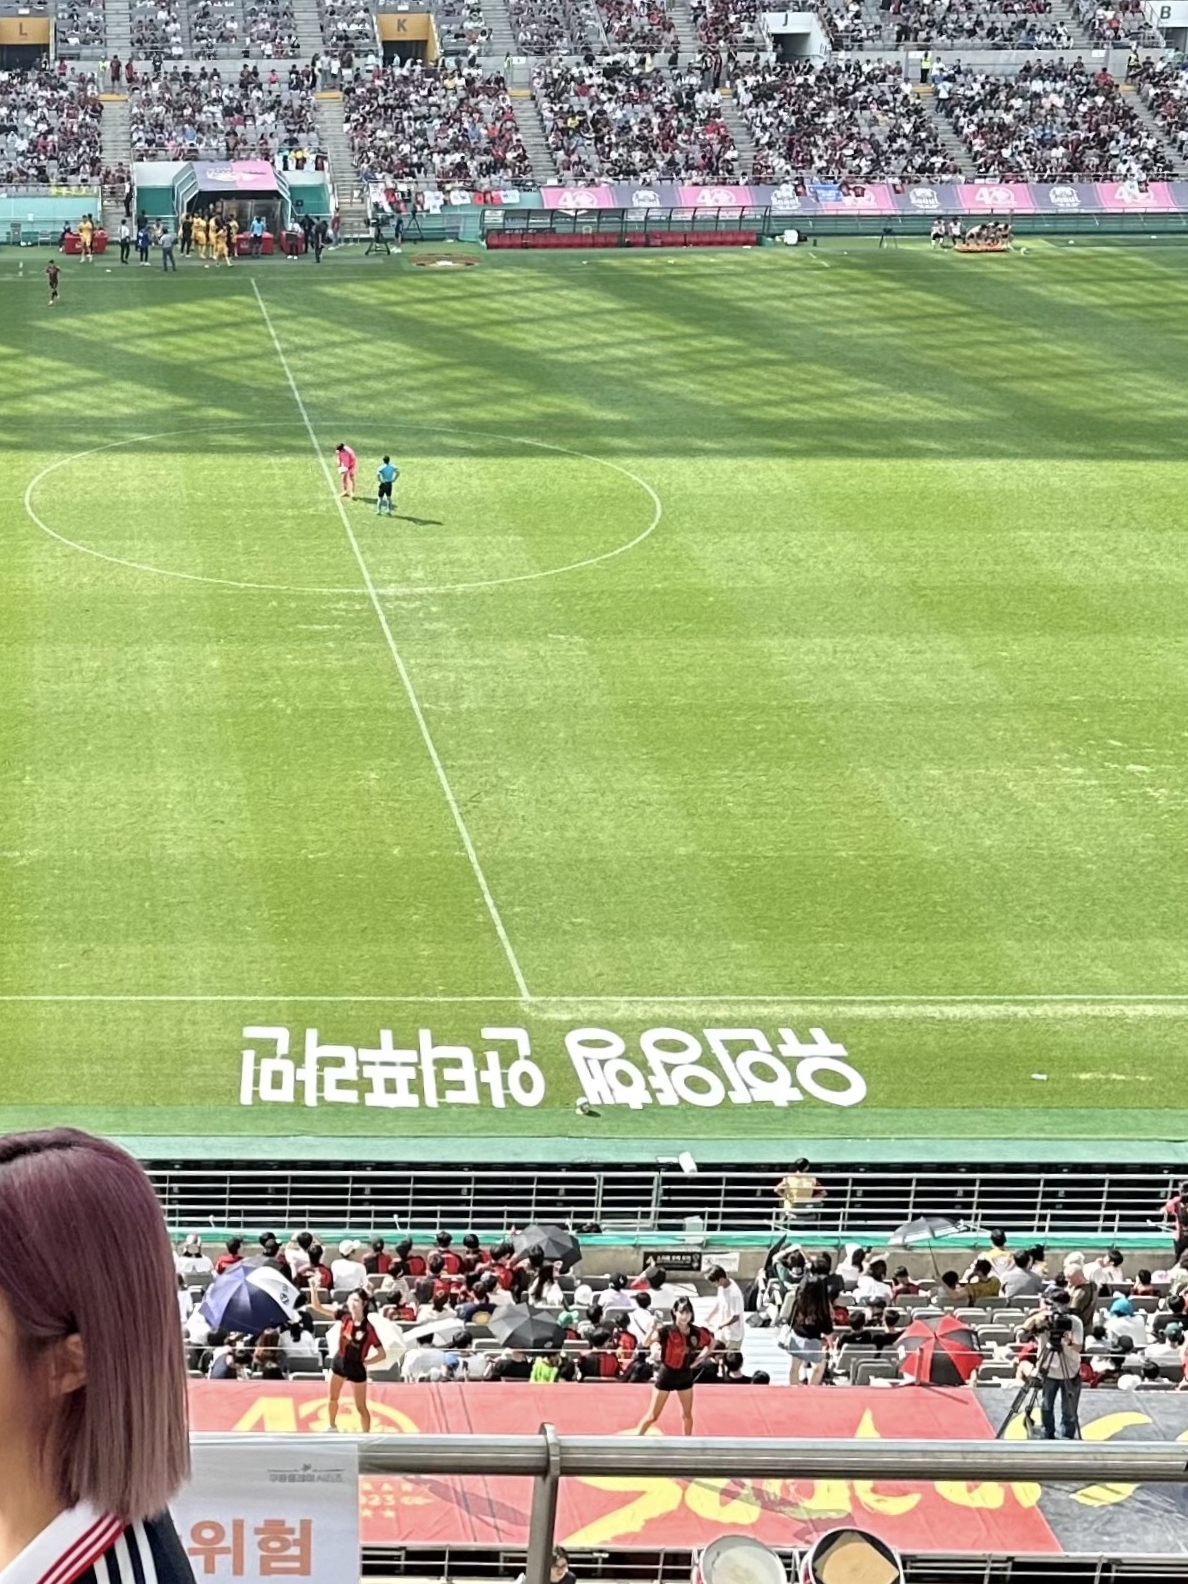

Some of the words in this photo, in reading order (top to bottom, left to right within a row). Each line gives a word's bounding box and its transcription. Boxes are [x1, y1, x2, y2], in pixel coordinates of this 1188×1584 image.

[782, 13, 789, 27] J
[1160, 6, 1172, 20] B
[19, 22, 28, 36] L
[397, 18, 407, 32] K
[240, 1026, 546, 1109] 안티푸라민
[564, 1026, 867, 1111] 유한양행
